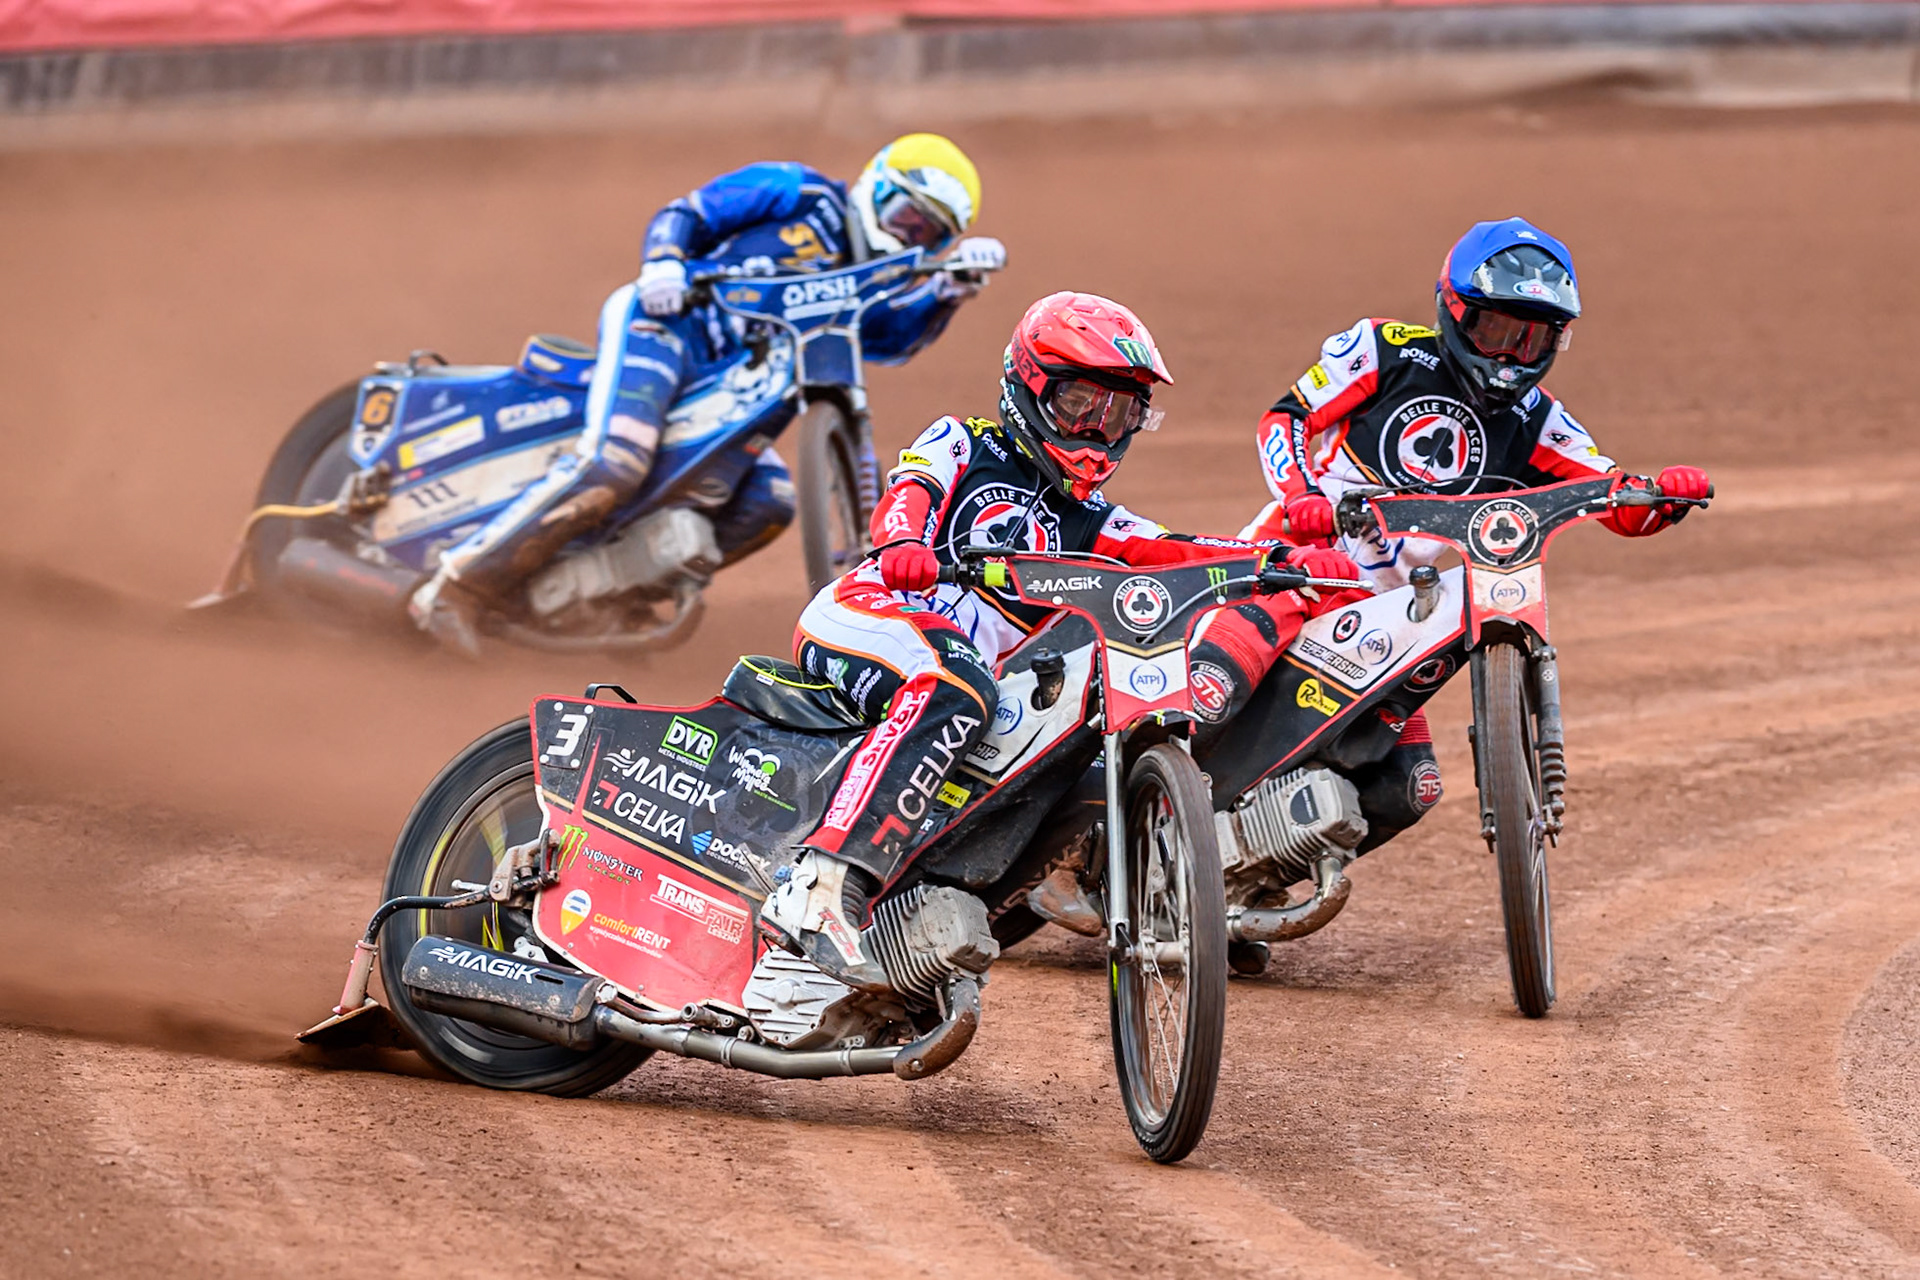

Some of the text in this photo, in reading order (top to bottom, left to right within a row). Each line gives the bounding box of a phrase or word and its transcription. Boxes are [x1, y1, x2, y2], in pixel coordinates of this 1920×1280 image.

[1399, 347, 1440, 366] ROWE
[361, 391, 395, 425] 6
[1400, 403, 1481, 463] BELLE VUE ACES
[974, 489, 1016, 508] BELLE
[1473, 503, 1533, 530] BELLE VUE ACES
[1117, 579, 1168, 600] BELLE VUE ACES
[1136, 674, 1161, 685] ATPI
[1191, 673, 1226, 708] STS
[546, 713, 588, 757] 3
[667, 721, 713, 758] DVR
[658, 747, 676, 760] METAL
[897, 714, 981, 820] CELKA
[940, 787, 964, 804] truck
[1417, 779, 1441, 797] STS
[613, 791, 687, 844] CELKA
[657, 874, 706, 915] TRANS
[593, 913, 672, 950] comfortRENT
[707, 908, 746, 939] FAIR
[707, 927, 741, 945] LESZNO
